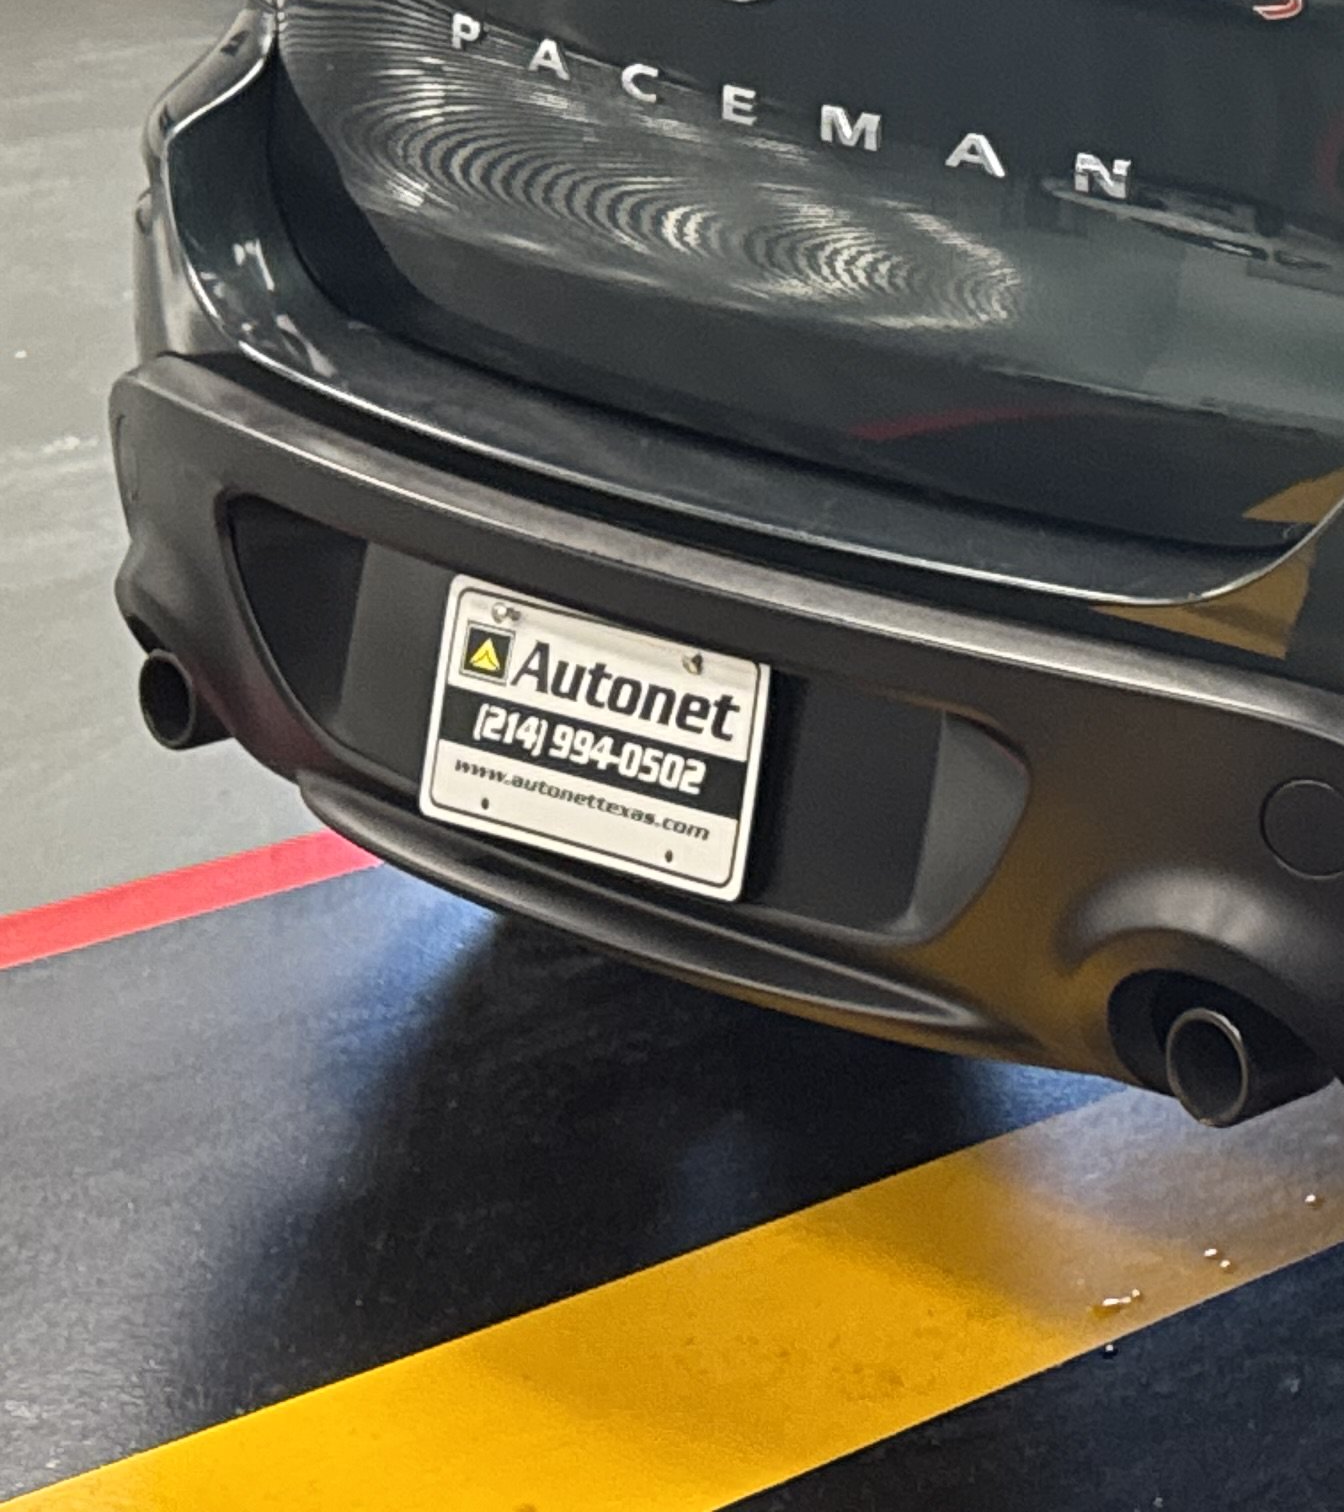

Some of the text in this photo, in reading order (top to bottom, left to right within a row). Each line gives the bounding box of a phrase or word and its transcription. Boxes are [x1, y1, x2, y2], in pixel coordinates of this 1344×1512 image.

[450, 11, 1133, 200] PACEMAN
[510, 640, 741, 741] Autonet
[472, 703, 707, 796] (214) 994-0502
[454, 758, 711, 841] www.autonettexas.com
